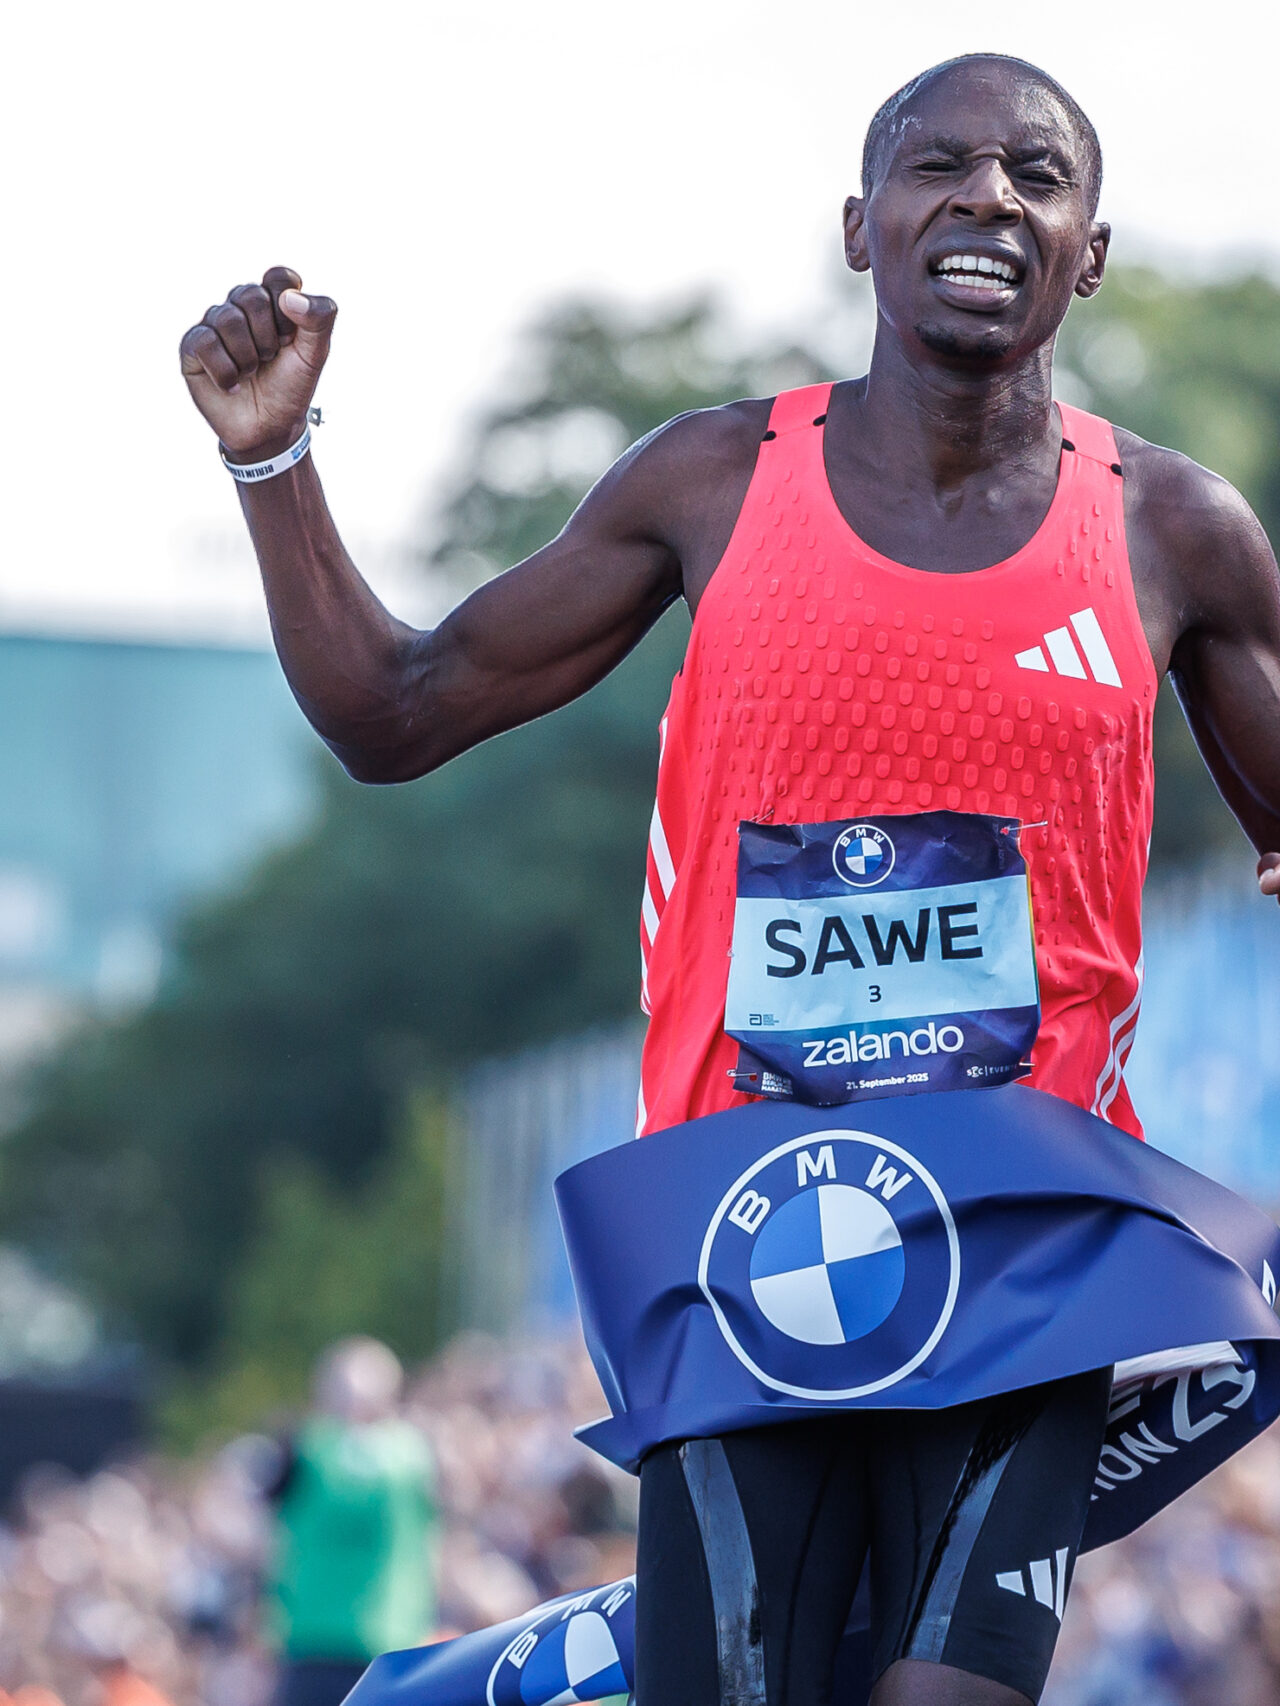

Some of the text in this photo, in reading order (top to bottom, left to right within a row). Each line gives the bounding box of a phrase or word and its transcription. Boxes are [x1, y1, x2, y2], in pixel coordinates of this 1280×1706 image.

[245, 464, 274, 478] BERLIN
[840, 828, 885, 848] BMW
[765, 902, 984, 978] SAWE
[868, 985, 882, 1003] 3
[802, 1022, 964, 1068] zalando
[846, 1072, 929, 1090] 21. September 2025
[728, 1144, 913, 1235] BMW
[507, 1584, 632, 1659] BMW
